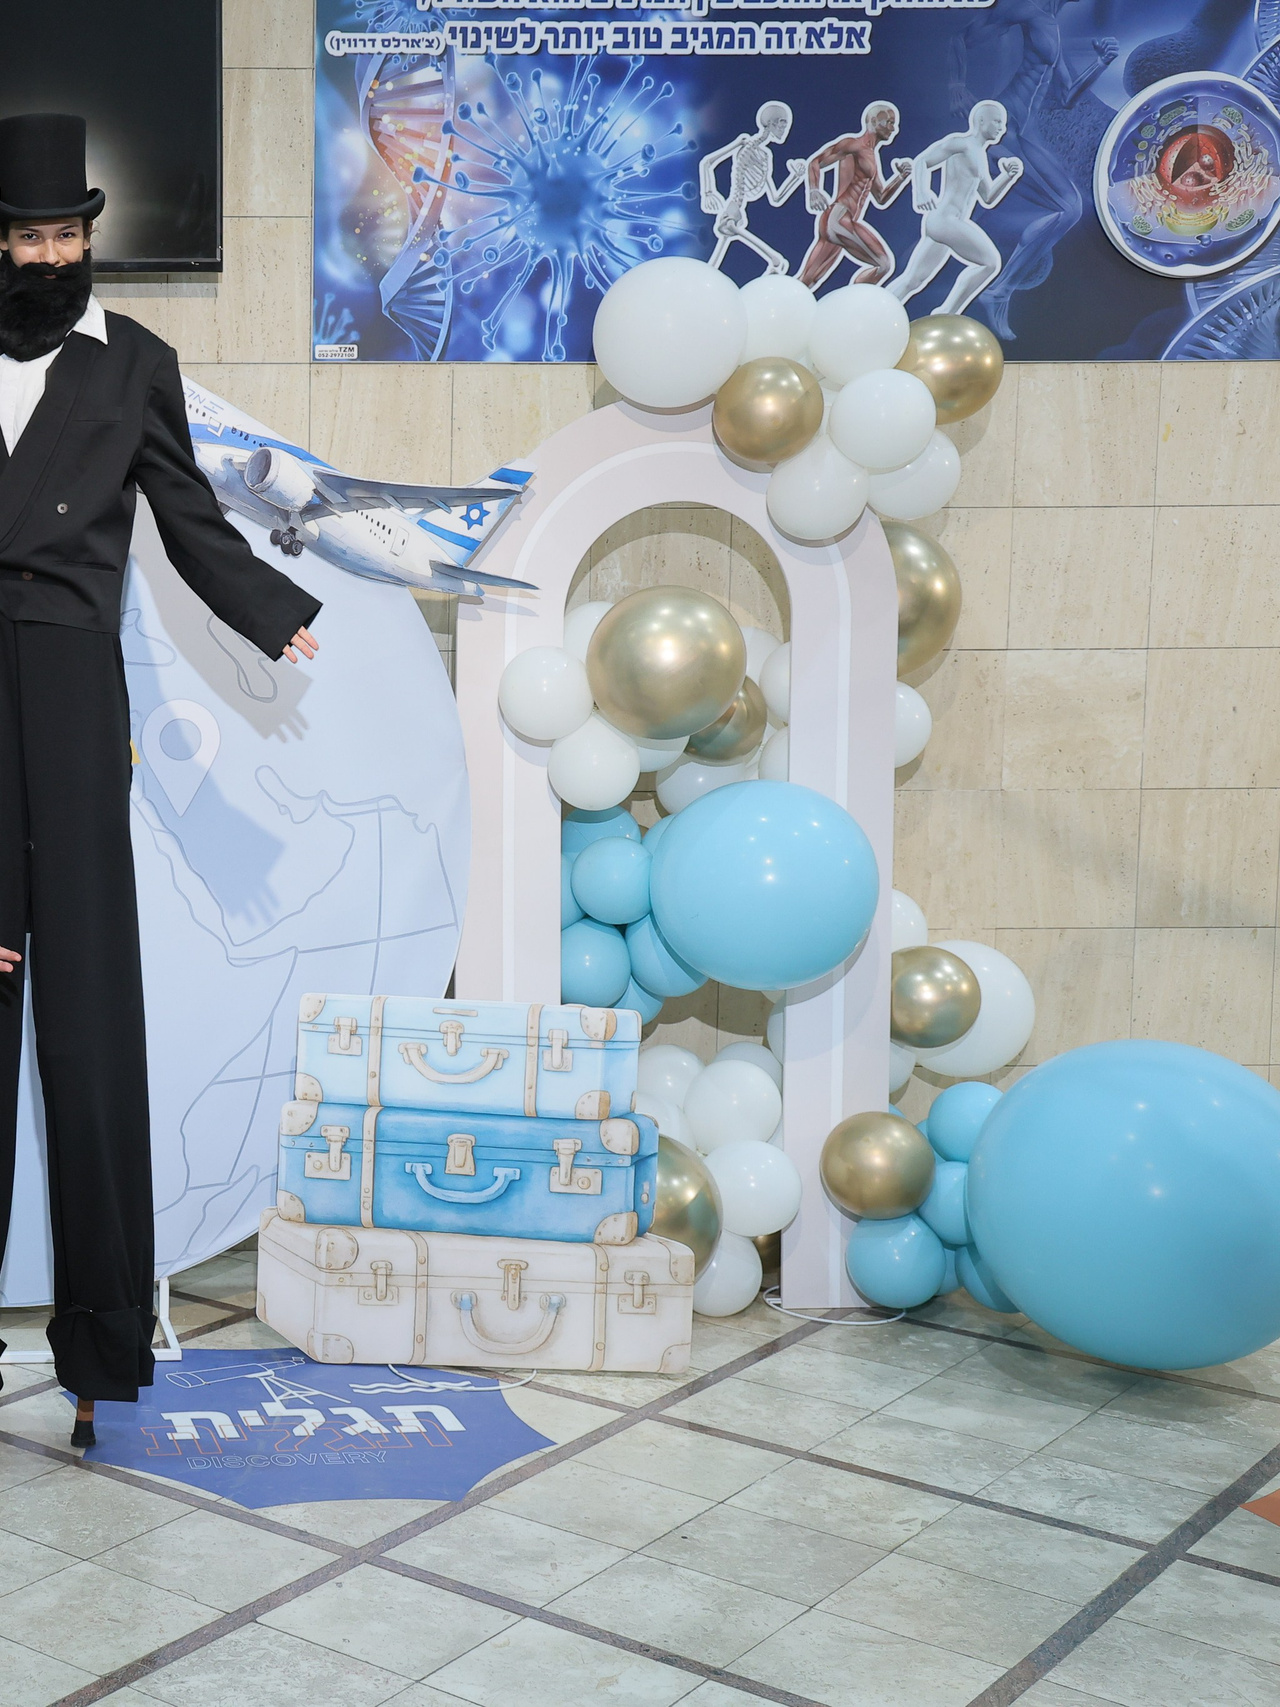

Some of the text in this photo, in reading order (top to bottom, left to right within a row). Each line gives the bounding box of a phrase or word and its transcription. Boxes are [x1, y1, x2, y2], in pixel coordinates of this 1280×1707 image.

[448, 22, 536, 49] לשינוי
[545, 26, 605, 50] יותר
[612, 26, 663, 50] טוב
[671, 26, 756, 50] המגיב
[765, 26, 799, 50] זה
[805, 22, 867, 50] אלא
[160, 1402, 467, 1442] תגלית
[185, 1450, 388, 1470] DISCOVERY
